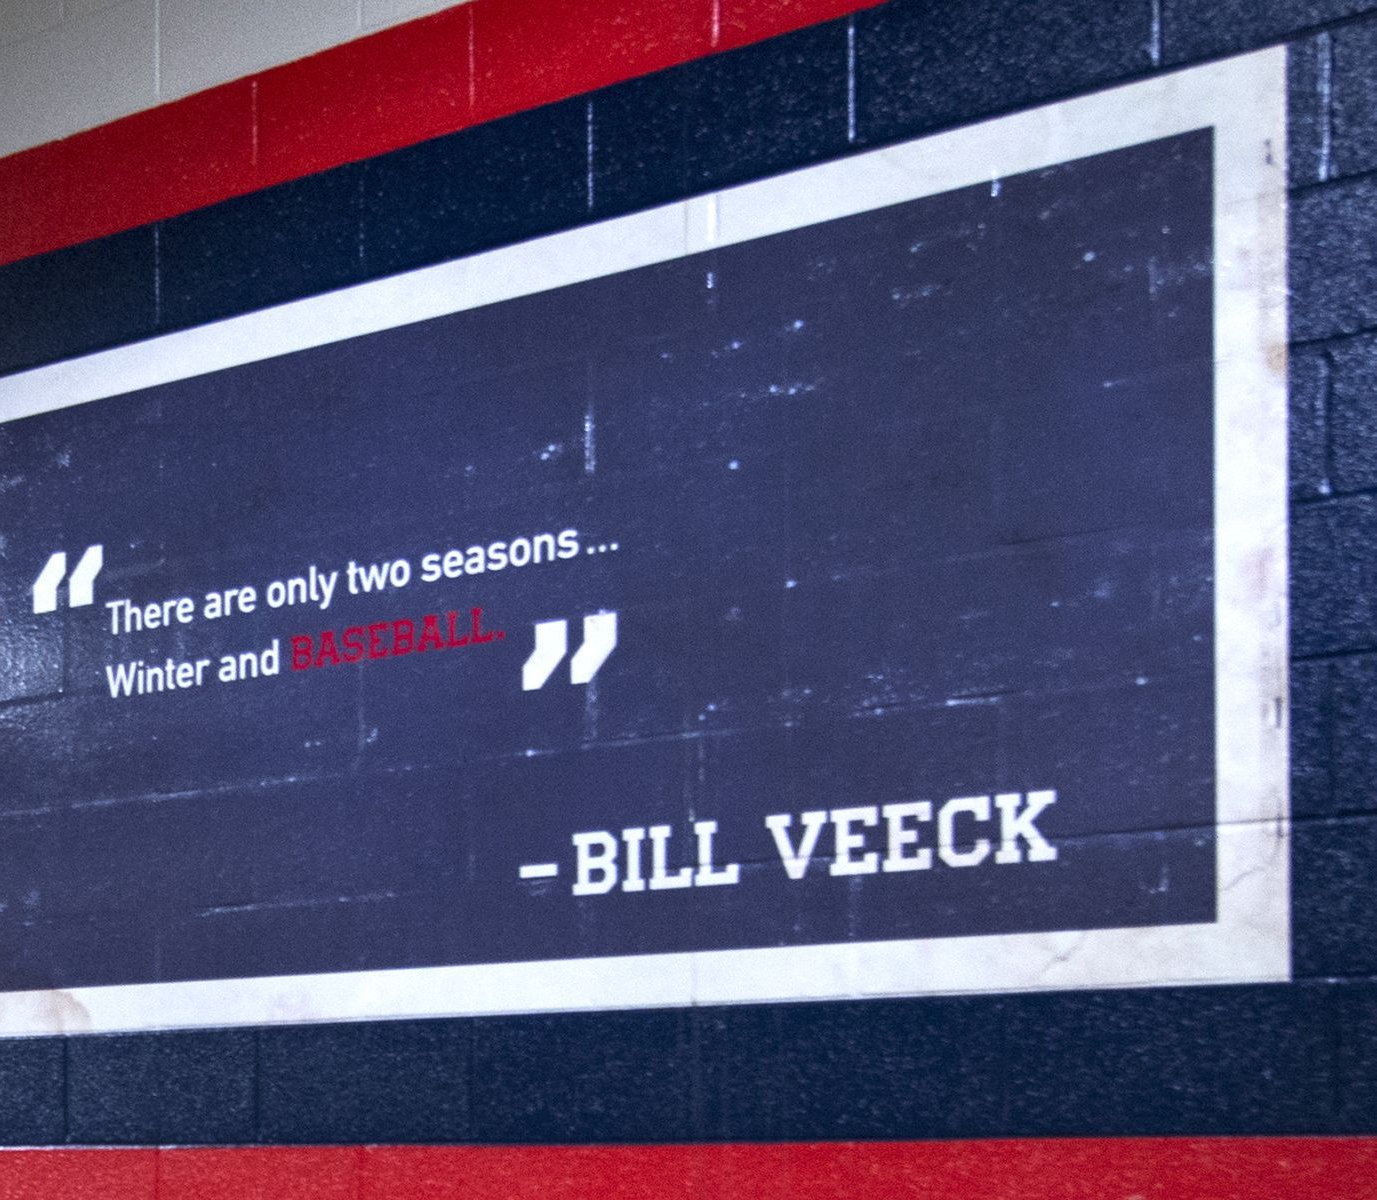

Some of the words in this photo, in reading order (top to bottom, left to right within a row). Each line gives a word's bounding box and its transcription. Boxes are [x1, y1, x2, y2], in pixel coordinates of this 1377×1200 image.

[105, 597, 195, 635] There
[203, 586, 257, 620] are
[266, 565, 339, 610] only
[346, 559, 411, 595] two
[105, 658, 211, 699] Winter
[218, 638, 280, 683] and
[291, 607, 506, 672] BASEBALL.
[765, 789, 1058, 880] VEECK
